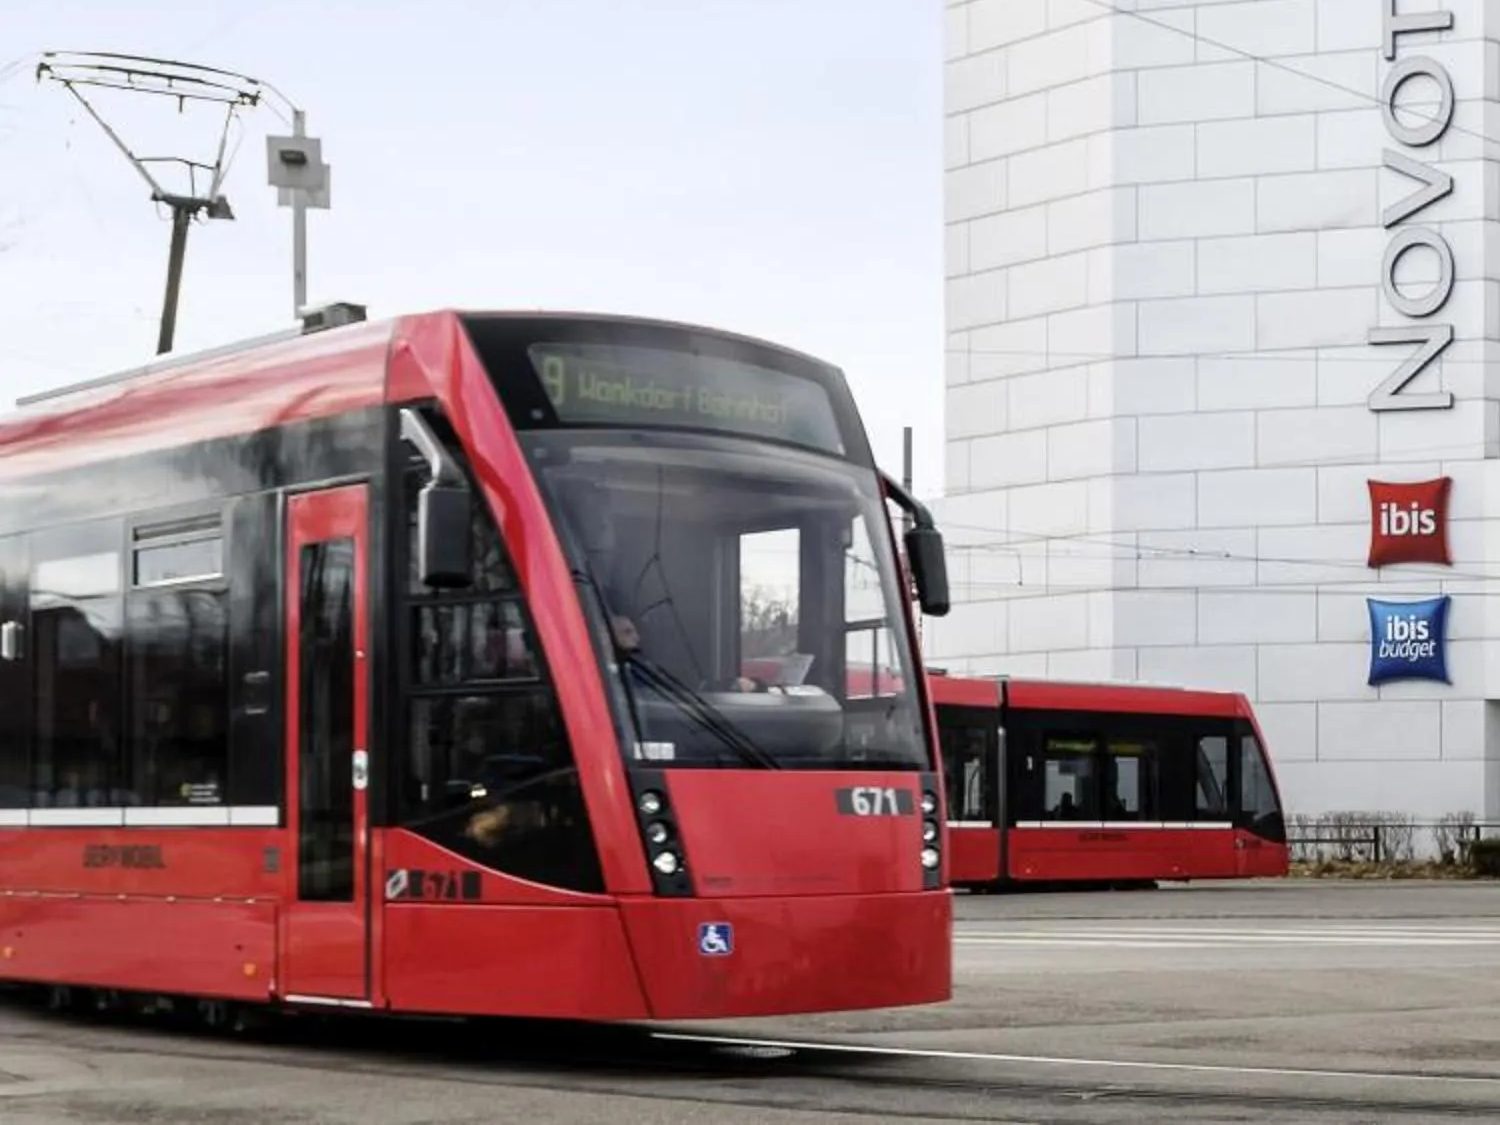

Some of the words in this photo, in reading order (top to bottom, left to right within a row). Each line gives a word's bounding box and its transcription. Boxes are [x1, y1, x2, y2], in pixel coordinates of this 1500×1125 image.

[543, 355, 564, 406] 9
[1379, 501, 1437, 536] ibis
[1386, 614, 1430, 641] ibis
[1379, 638, 1437, 662] budget
[851, 786, 899, 816] 671
